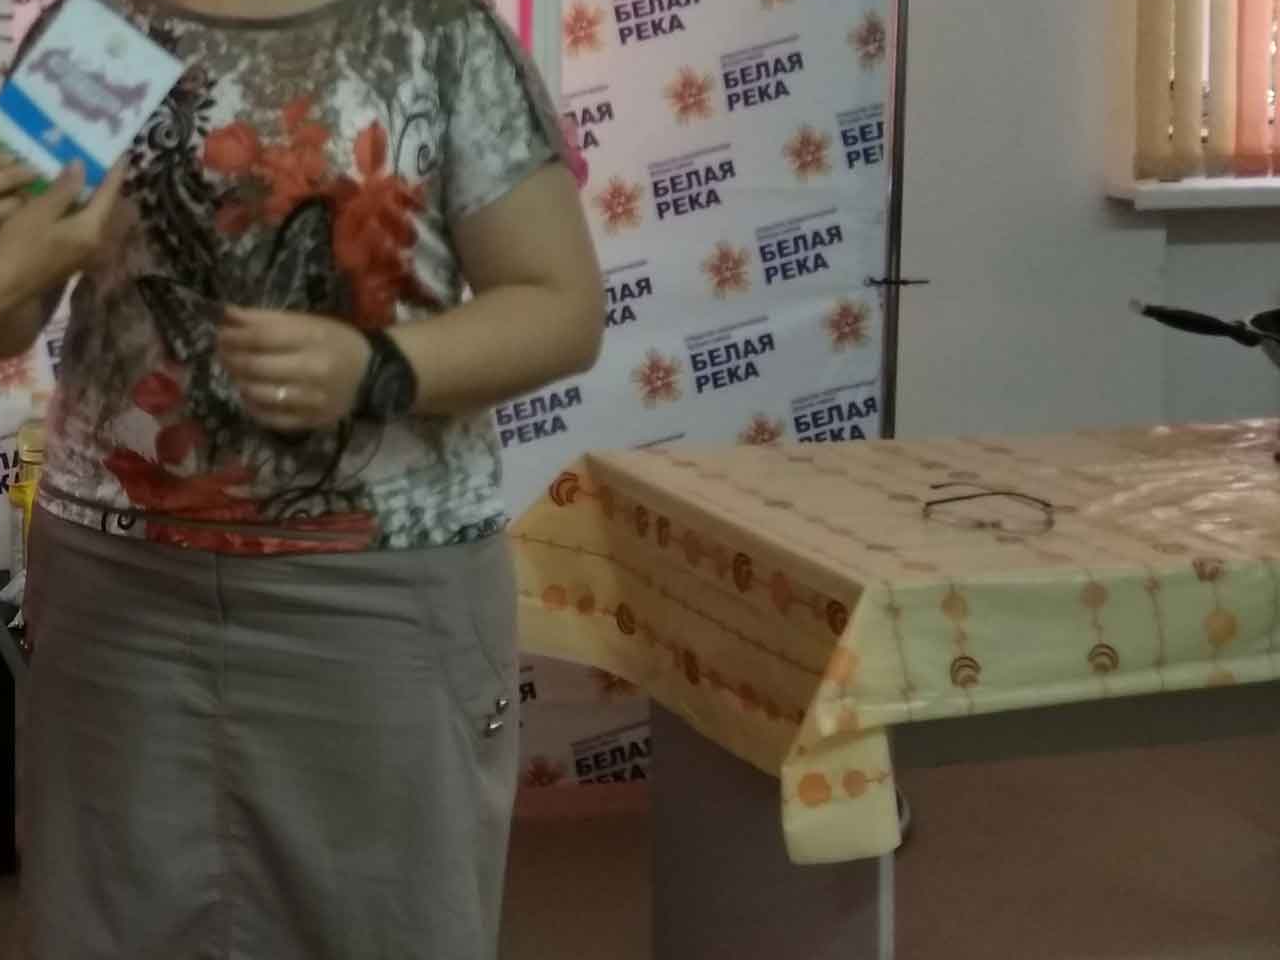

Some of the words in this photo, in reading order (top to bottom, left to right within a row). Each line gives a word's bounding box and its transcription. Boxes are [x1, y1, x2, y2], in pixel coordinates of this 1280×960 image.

[619, 13, 686, 45] РЕКА
[723, 51, 805, 90] БЕЛАЯ
[727, 79, 791, 112] РЕКА
[653, 160, 737, 199] БЕЛАЯ
[657, 188, 722, 220] РЕКА
[759, 224, 843, 263] БЕЛАЯ
[764, 252, 830, 286] РЕКА
[690, 333, 775, 373] БЕЛАЯ
[695, 361, 760, 394] РЕКА
[496, 386, 582, 426] БЕЛАЯ
[793, 396, 878, 434] БЕЛАЯ
[500, 415, 567, 448] РЕКА
